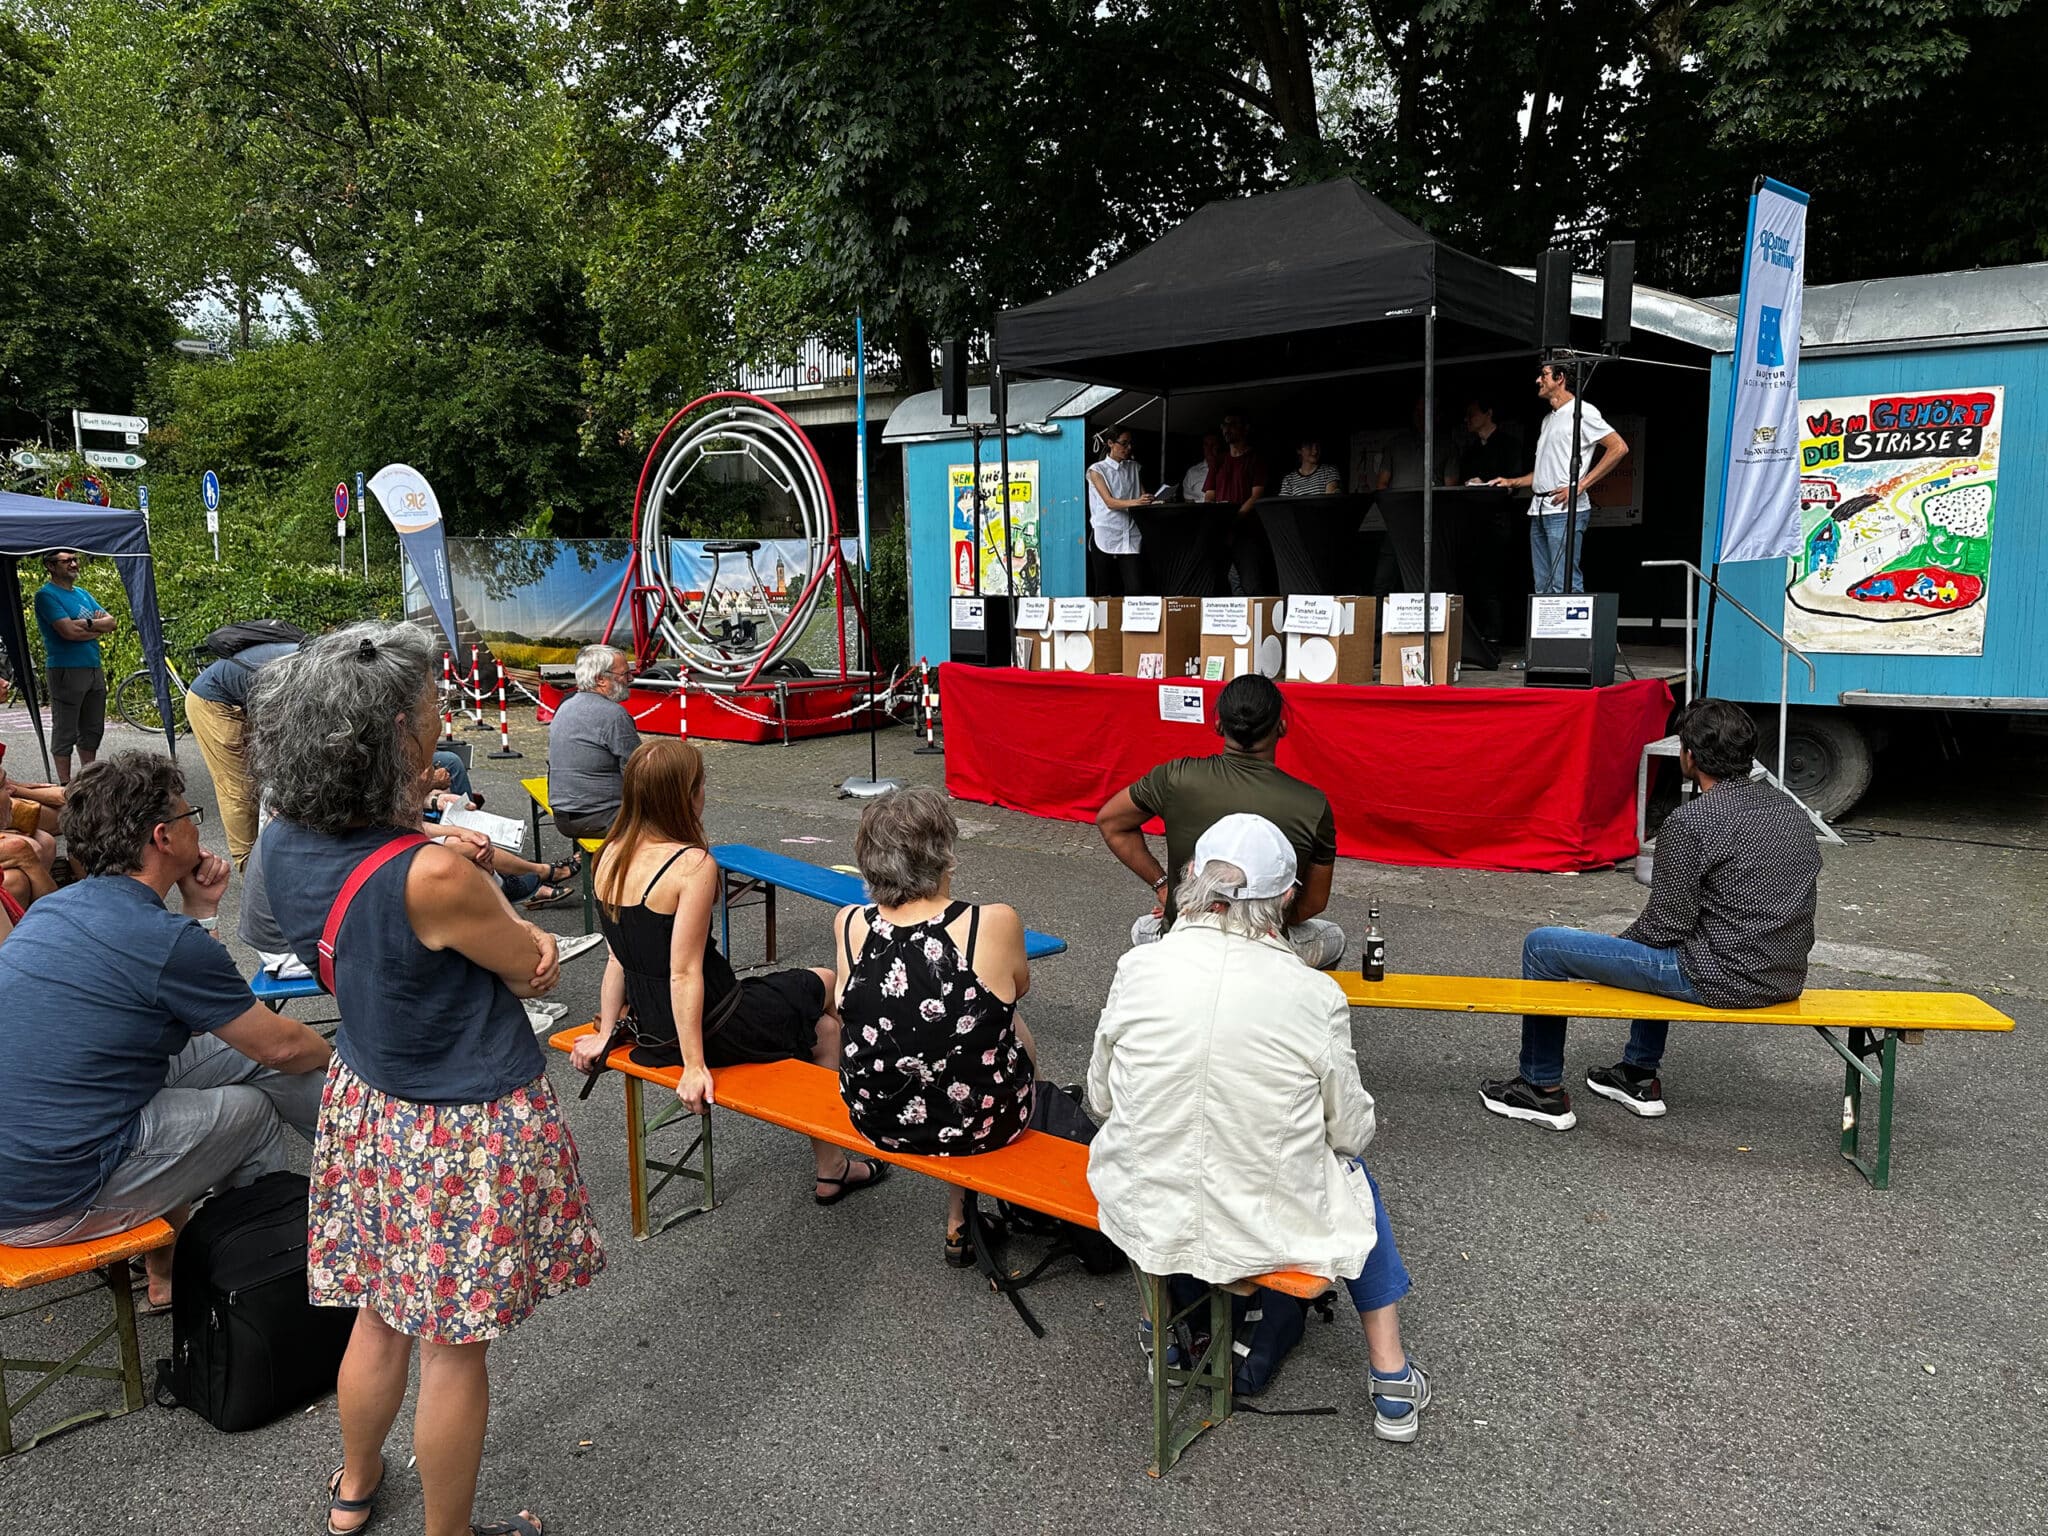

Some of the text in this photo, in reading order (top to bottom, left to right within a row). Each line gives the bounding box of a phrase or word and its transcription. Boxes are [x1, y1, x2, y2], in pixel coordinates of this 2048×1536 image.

[1807, 400, 1990, 437] WEM GEHÖRT
[1804, 441, 1840, 467] DIE
